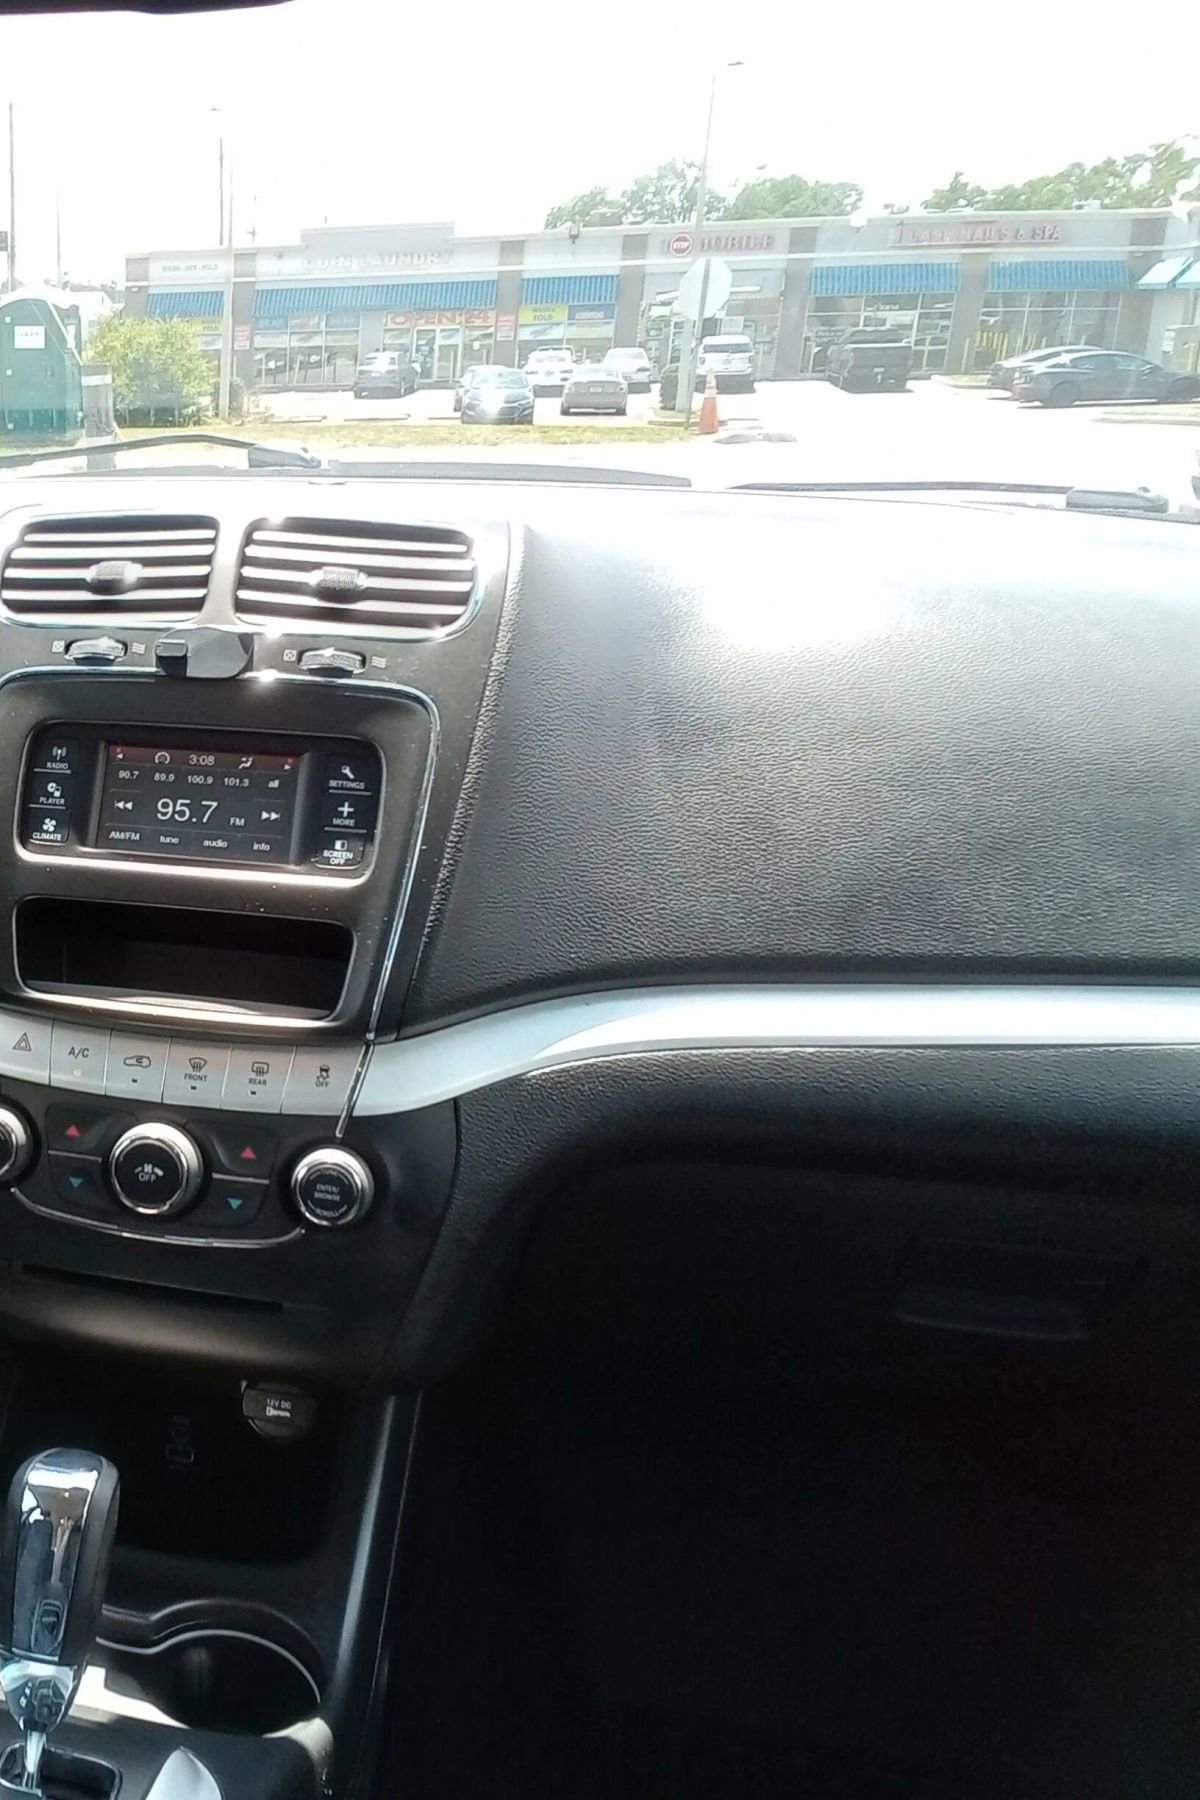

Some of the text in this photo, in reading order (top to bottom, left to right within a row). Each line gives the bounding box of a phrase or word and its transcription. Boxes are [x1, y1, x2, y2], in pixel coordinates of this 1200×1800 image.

[1032, 226, 1062, 240] SPA
[673, 241, 690, 250] STOP
[359, 250, 455, 268] LAUNDRY
[391, 312, 457, 325] OPEN
[188, 754, 215, 766] 3:08
[117, 770, 140, 779] 90.7
[153, 772, 175, 782] 89.9
[186, 775, 214, 784] 100.9
[223, 777, 250, 787] 101.3
[267, 779, 280, 789] all
[328, 779, 365, 789] SETTINGS
[39, 796, 65, 805] PLAYER
[156, 798, 245, 827] 95.7 FM
[332, 817, 355, 827] MORE
[32, 831, 62, 841] CLIMATE
[159, 835, 180, 844] tune
[203, 839, 228, 848] audio
[253, 842, 271, 851] info
[322, 850, 354, 859] SCREEN
[329, 857, 346, 865] OFF
[68, 1046, 90, 1059] A/C
[183, 1073, 208, 1082] FRONT
[248, 1077, 267, 1086] REAR
[315, 1080, 329, 1088] OFF
[138, 1172, 157, 1183] OFF
[266, 1398, 292, 1409] 12V DC
